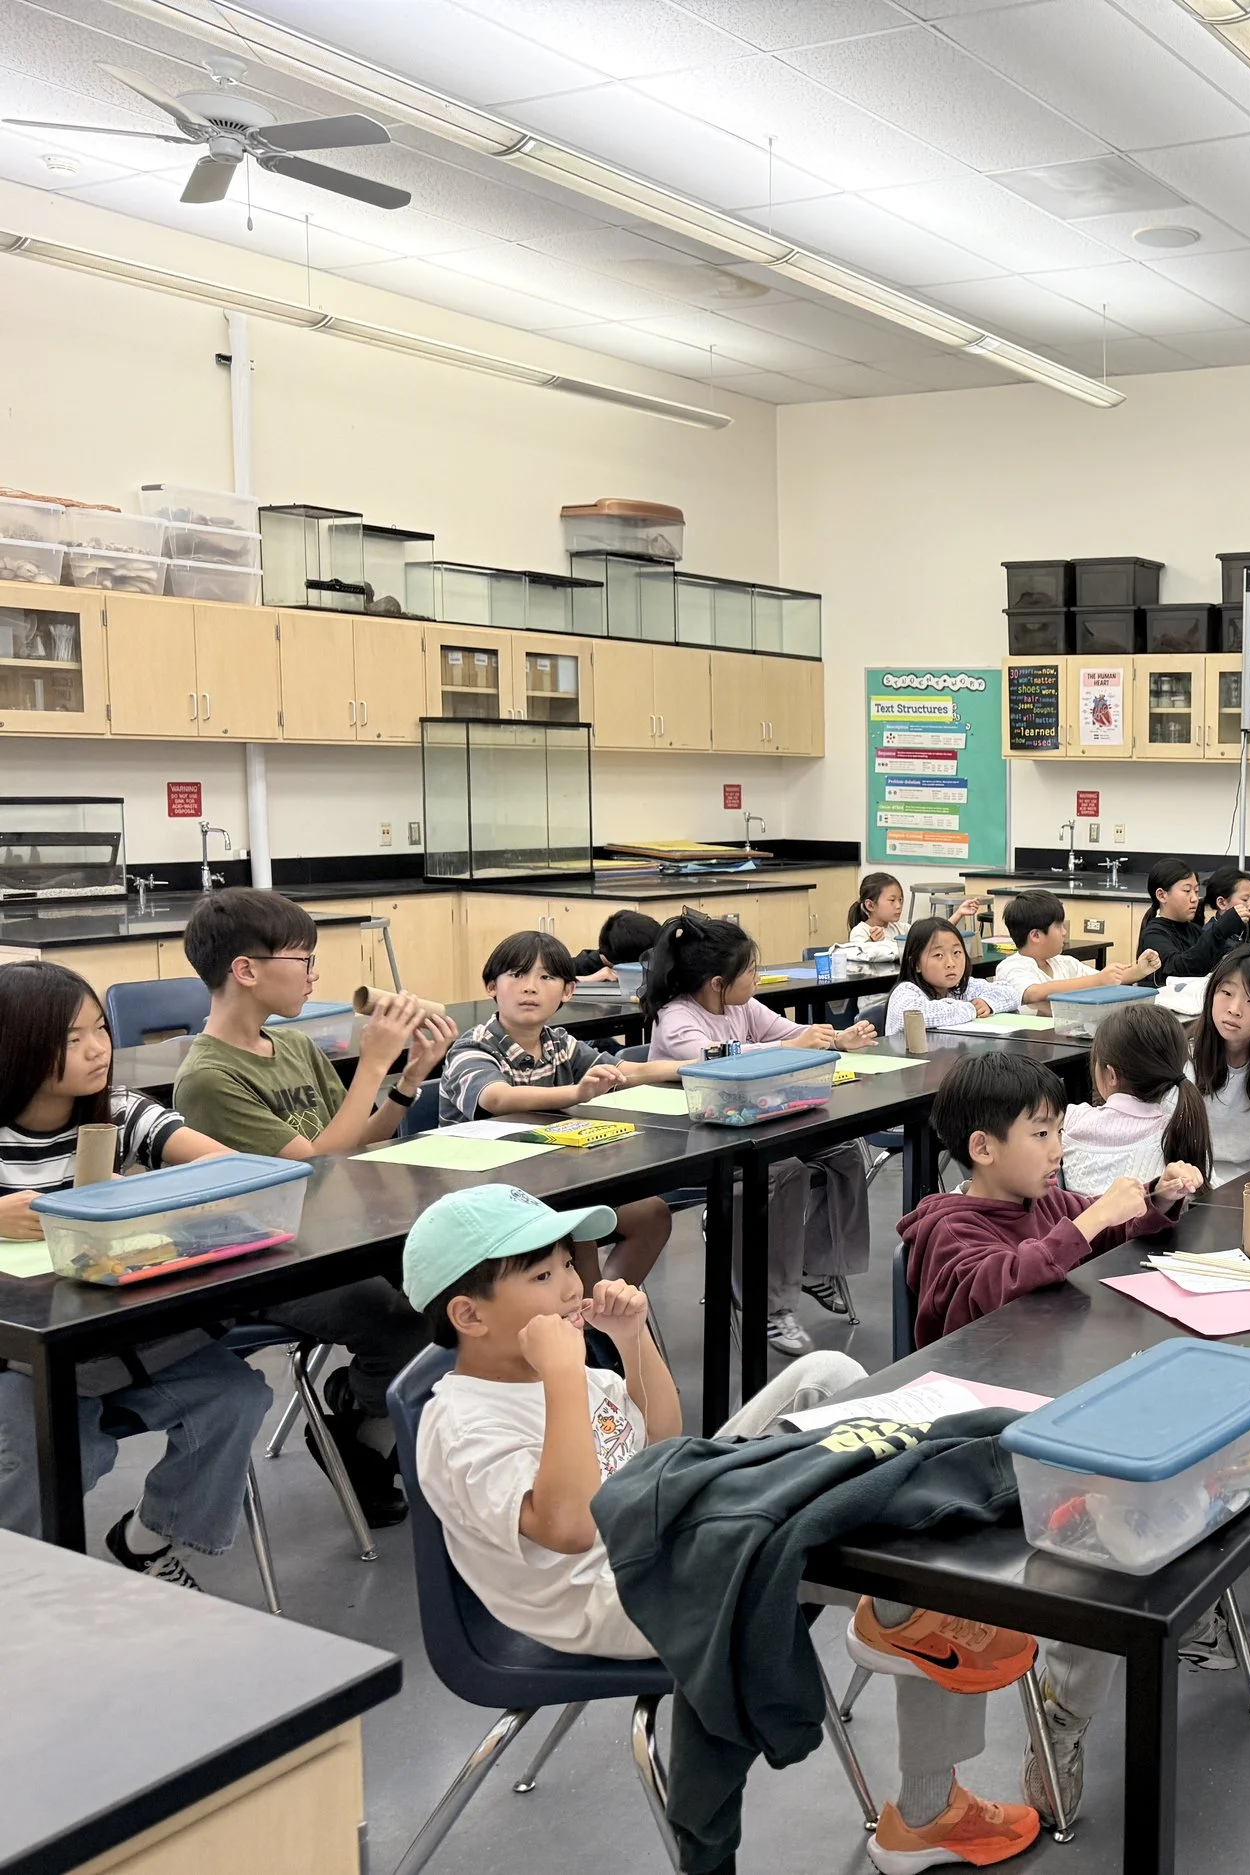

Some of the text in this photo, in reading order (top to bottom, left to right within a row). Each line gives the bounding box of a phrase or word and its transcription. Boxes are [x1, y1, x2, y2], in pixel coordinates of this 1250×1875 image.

[1010, 670, 1018, 678] 30
[1018, 684, 1040, 694] shoes
[874, 704, 894, 713] Text
[897, 704, 948, 714] Structures
[1020, 728, 1056, 736] learned
